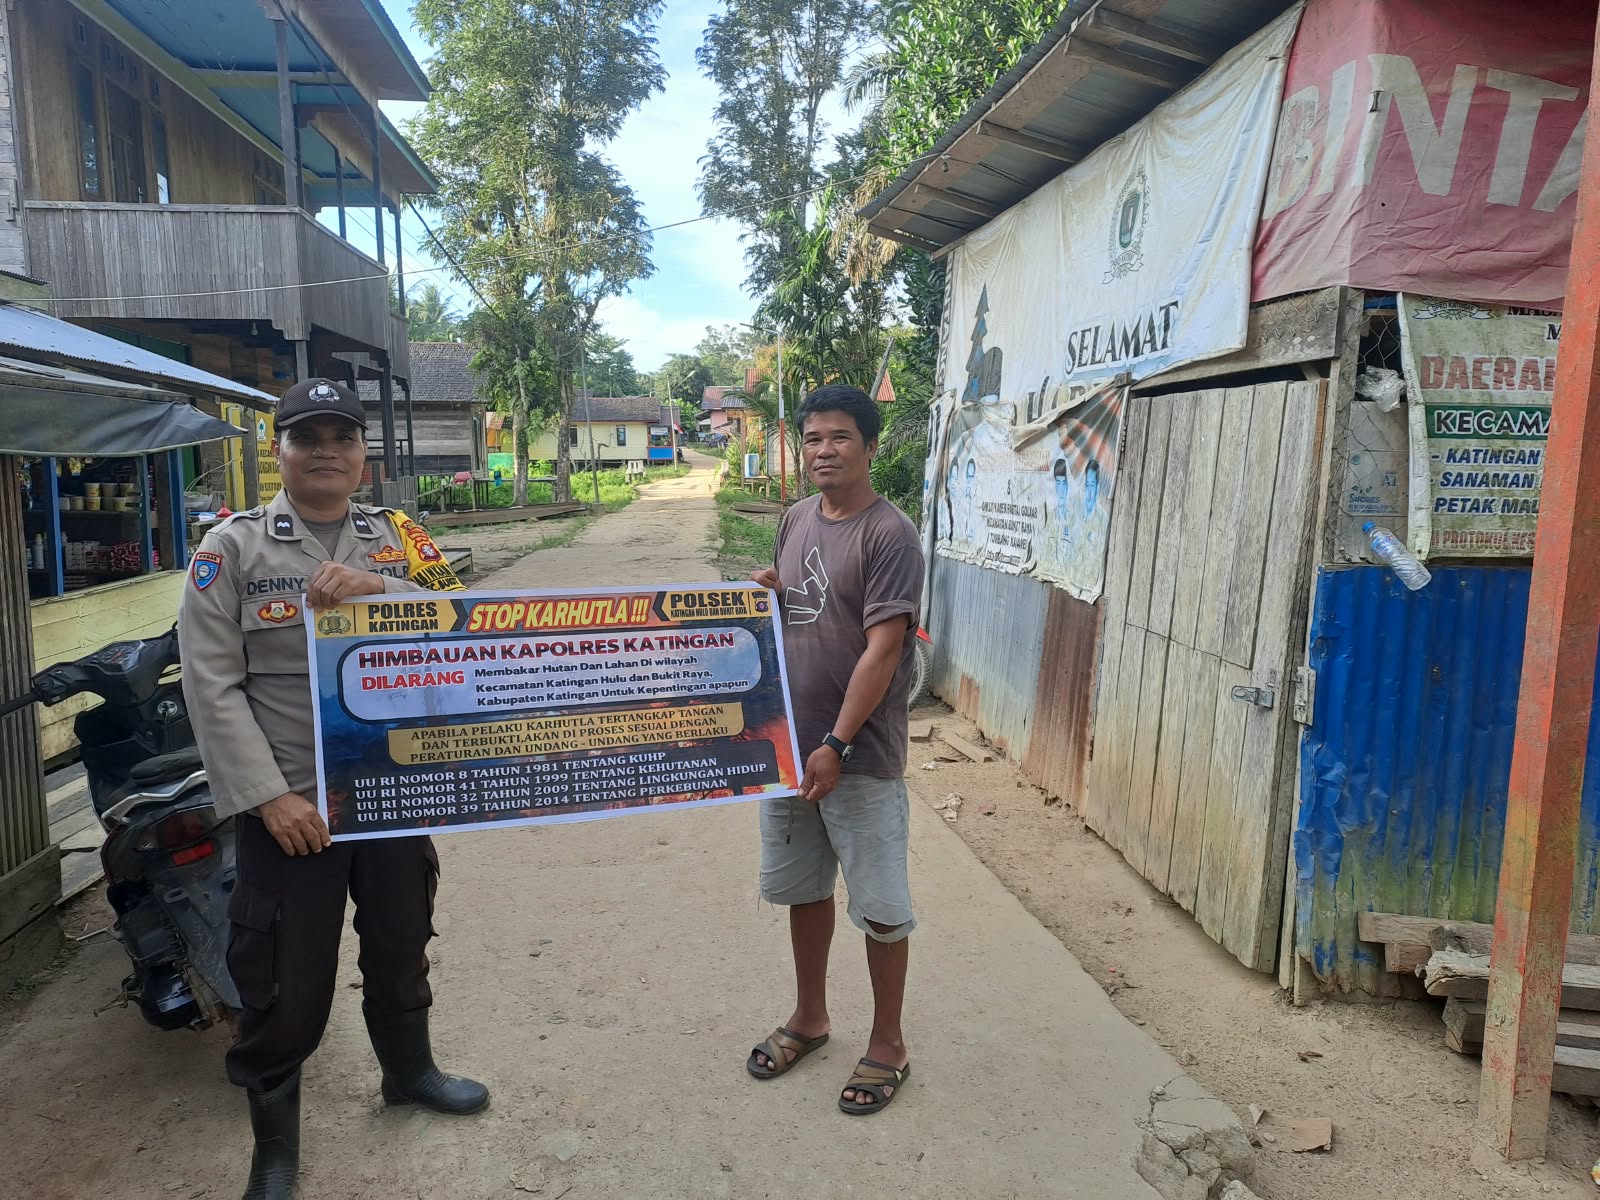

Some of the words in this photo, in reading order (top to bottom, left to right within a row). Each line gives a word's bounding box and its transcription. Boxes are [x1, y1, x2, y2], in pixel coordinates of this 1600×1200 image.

[1065, 301, 1178, 375] SELAMAT
[1446, 449, 1539, 464] KATINGAN
[1440, 472, 1534, 487] SANAMAN
[1434, 498, 1496, 513] PETAK
[247, 578, 304, 595] DENNY
[670, 592, 744, 608] POLSEK
[368, 602, 438, 620] POLRES
[369, 619, 438, 633] KATINGAN
[359, 646, 496, 668] HIMBAUAN
[501, 638, 619, 659] KAPOLRES
[624, 633, 734, 652] KATINGAN
[362, 671, 464, 690] DILARANG
[475, 666, 540, 677] Membakar
[543, 664, 577, 673] Hutan
[580, 662, 602, 670] Dan
[605, 660, 638, 668] Lahan
[641, 658, 652, 666] Di
[655, 656, 697, 666] wilayah
[476, 682, 543, 692] Kecamatan
[546, 678, 598, 688] Katingan
[601, 674, 626, 684] Hulu
[629, 674, 649, 682] dan
[652, 672, 681, 680] Bukit
[683, 670, 713, 679] Raya,
[477, 695, 544, 706] Kabupaten
[546, 692, 599, 701] Katingan
[602, 687, 635, 697] Untuk
[638, 684, 706, 696] Kepentingan
[709, 680, 748, 689] apapun
[411, 728, 467, 740] APABILA
[472, 723, 522, 736] PELAKU
[527, 717, 594, 730] KARHUTLA
[598, 711, 675, 724] TERTANGKAP
[678, 706, 724, 717] TANGAN
[422, 740, 449, 750] DAN
[563, 730, 576, 738] DI
[580, 726, 624, 737] PROSES
[628, 723, 667, 733] SESUAI
[671, 718, 716, 728] DENGAN
[410, 748, 490, 762] PERATURAN
[495, 746, 521, 756] DAN
[526, 739, 578, 752] UNDANG
[589, 734, 639, 747] UNDANG
[642, 732, 672, 741] YANG
[676, 727, 728, 738] BERLAKU
[355, 778, 376, 788] UU
[380, 777, 395, 786] RI
[400, 772, 455, 784] NOMOR
[459, 771, 467, 779] 8
[471, 766, 520, 778] TAHUN
[525, 764, 559, 774] 1981
[563, 755, 625, 769] TENTANG
[630, 752, 665, 764] KUHP
[356, 790, 376, 799] UU
[381, 788, 395, 797] RI
[400, 784, 456, 796] NOMOR
[459, 782, 476, 790] 41
[481, 777, 530, 789] TAHUN
[535, 774, 568, 784] 1999
[572, 766, 635, 780] TENTANG
[639, 758, 717, 774] KEHUTANAN
[357, 801, 377, 810] UU
[382, 800, 396, 809] RI
[401, 795, 456, 808] NOMOR
[460, 793, 477, 802] 32
[481, 788, 530, 800] TAHUN
[534, 785, 569, 795] 2009
[572, 778, 635, 791] TENTANG
[640, 768, 724, 785] LINGKUNGAN
[727, 764, 766, 775] HIDUP
[357, 813, 377, 822] UU
[382, 811, 397, 820] RI
[402, 807, 457, 819] NOMOR
[461, 804, 478, 813] 39
[482, 799, 530, 812] TAHUN
[535, 796, 569, 806] 2014
[573, 789, 636, 803] TENTANG
[640, 779, 728, 796] PERKEBUNAN
